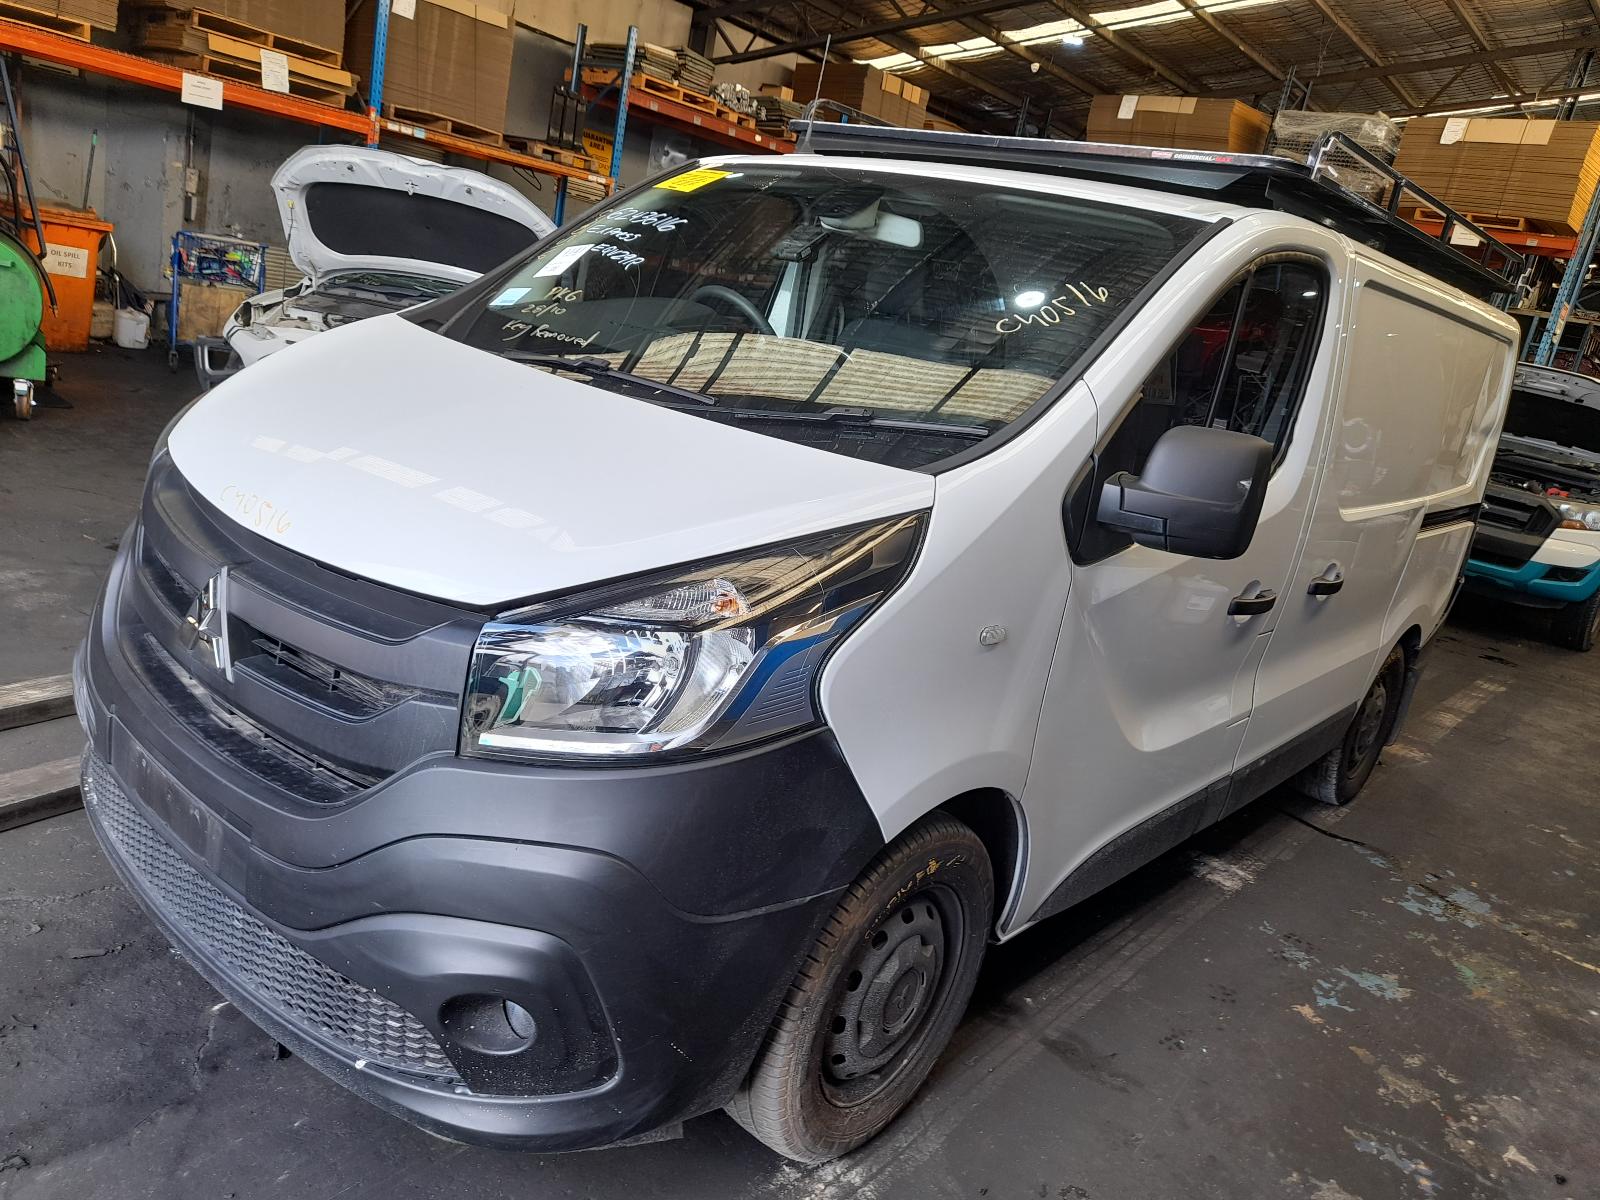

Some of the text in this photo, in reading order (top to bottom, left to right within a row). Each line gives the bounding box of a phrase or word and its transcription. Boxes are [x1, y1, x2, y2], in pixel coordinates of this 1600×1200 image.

[590, 141, 605, 152] AREA
[50, 249, 81, 260] OIL SPILL
[57, 260, 73, 269] KITS
